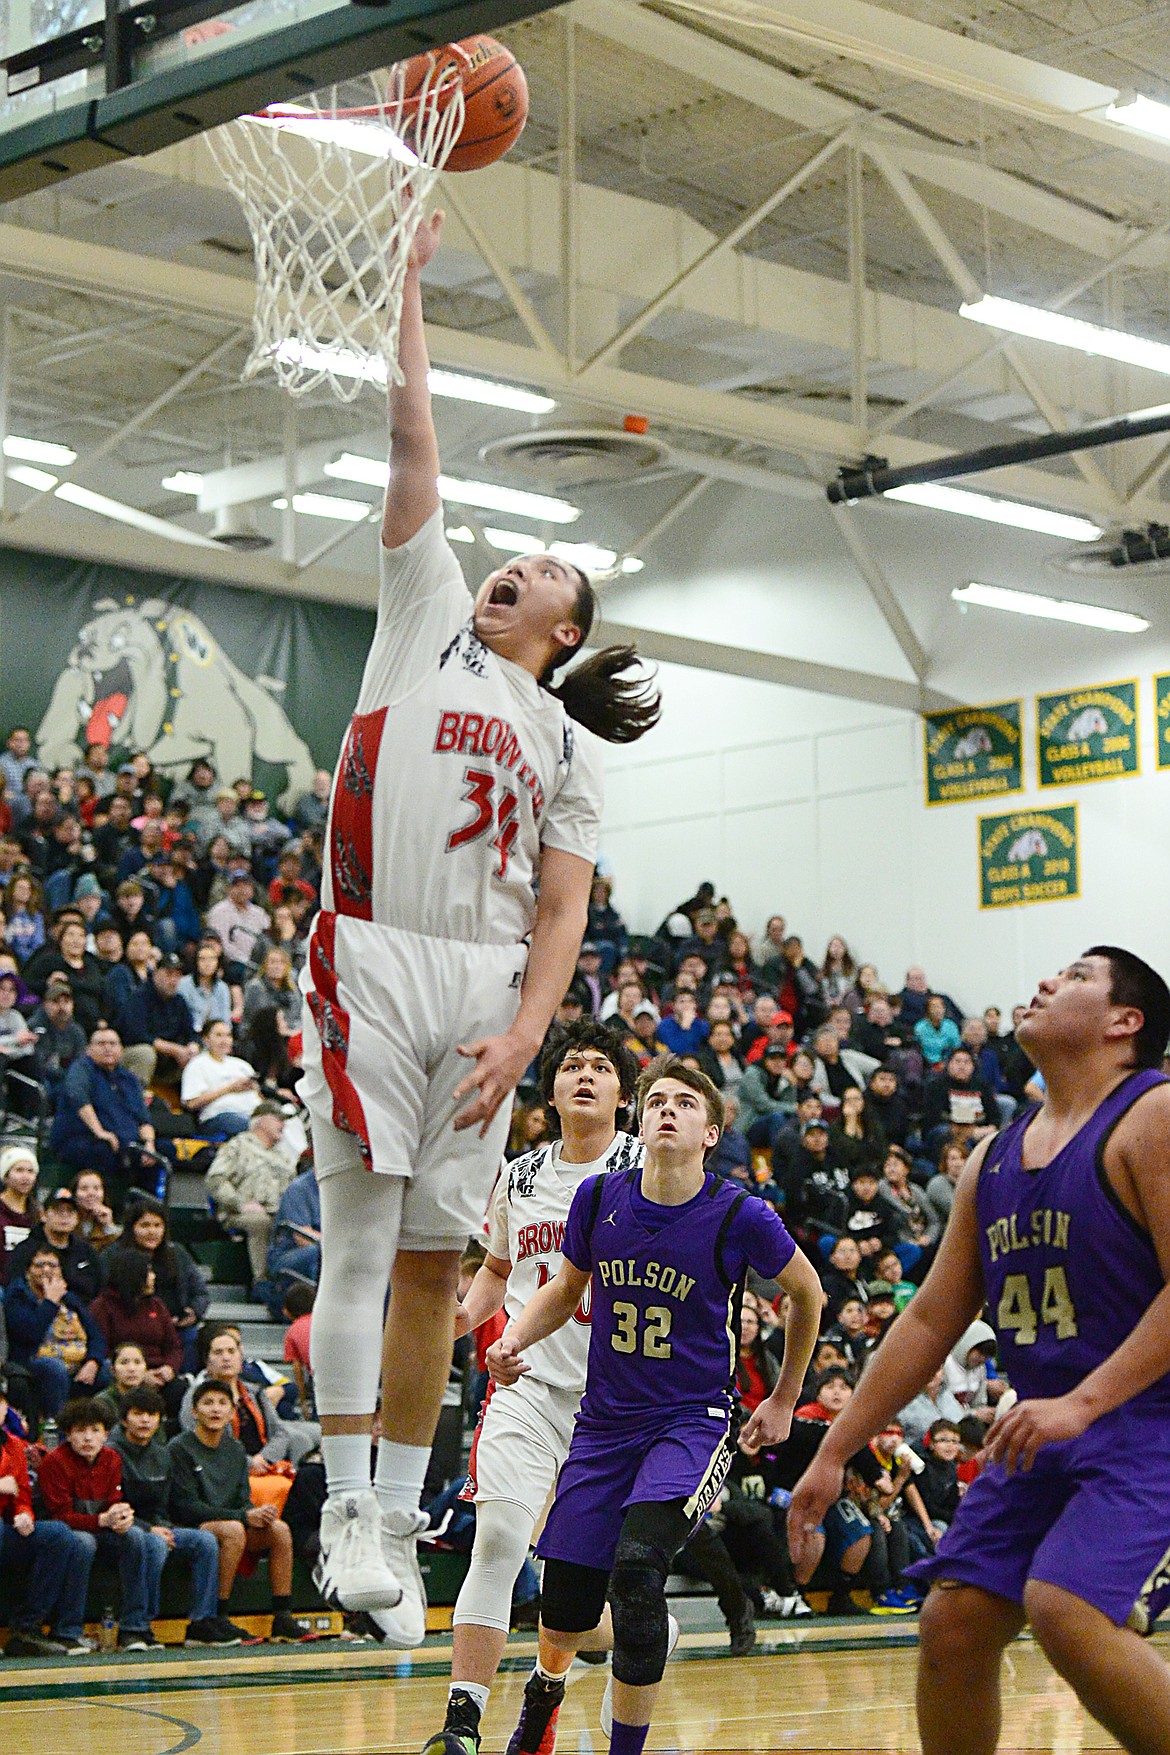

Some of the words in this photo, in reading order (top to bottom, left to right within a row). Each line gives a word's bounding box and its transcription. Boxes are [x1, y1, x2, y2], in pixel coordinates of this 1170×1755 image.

[516, 1219, 566, 1262] BROW
[598, 1259, 696, 1302] POLSON
[997, 1266, 1078, 1346] 44
[610, 1300, 672, 1359] 32
[696, 1443, 731, 1521] PIRATES
